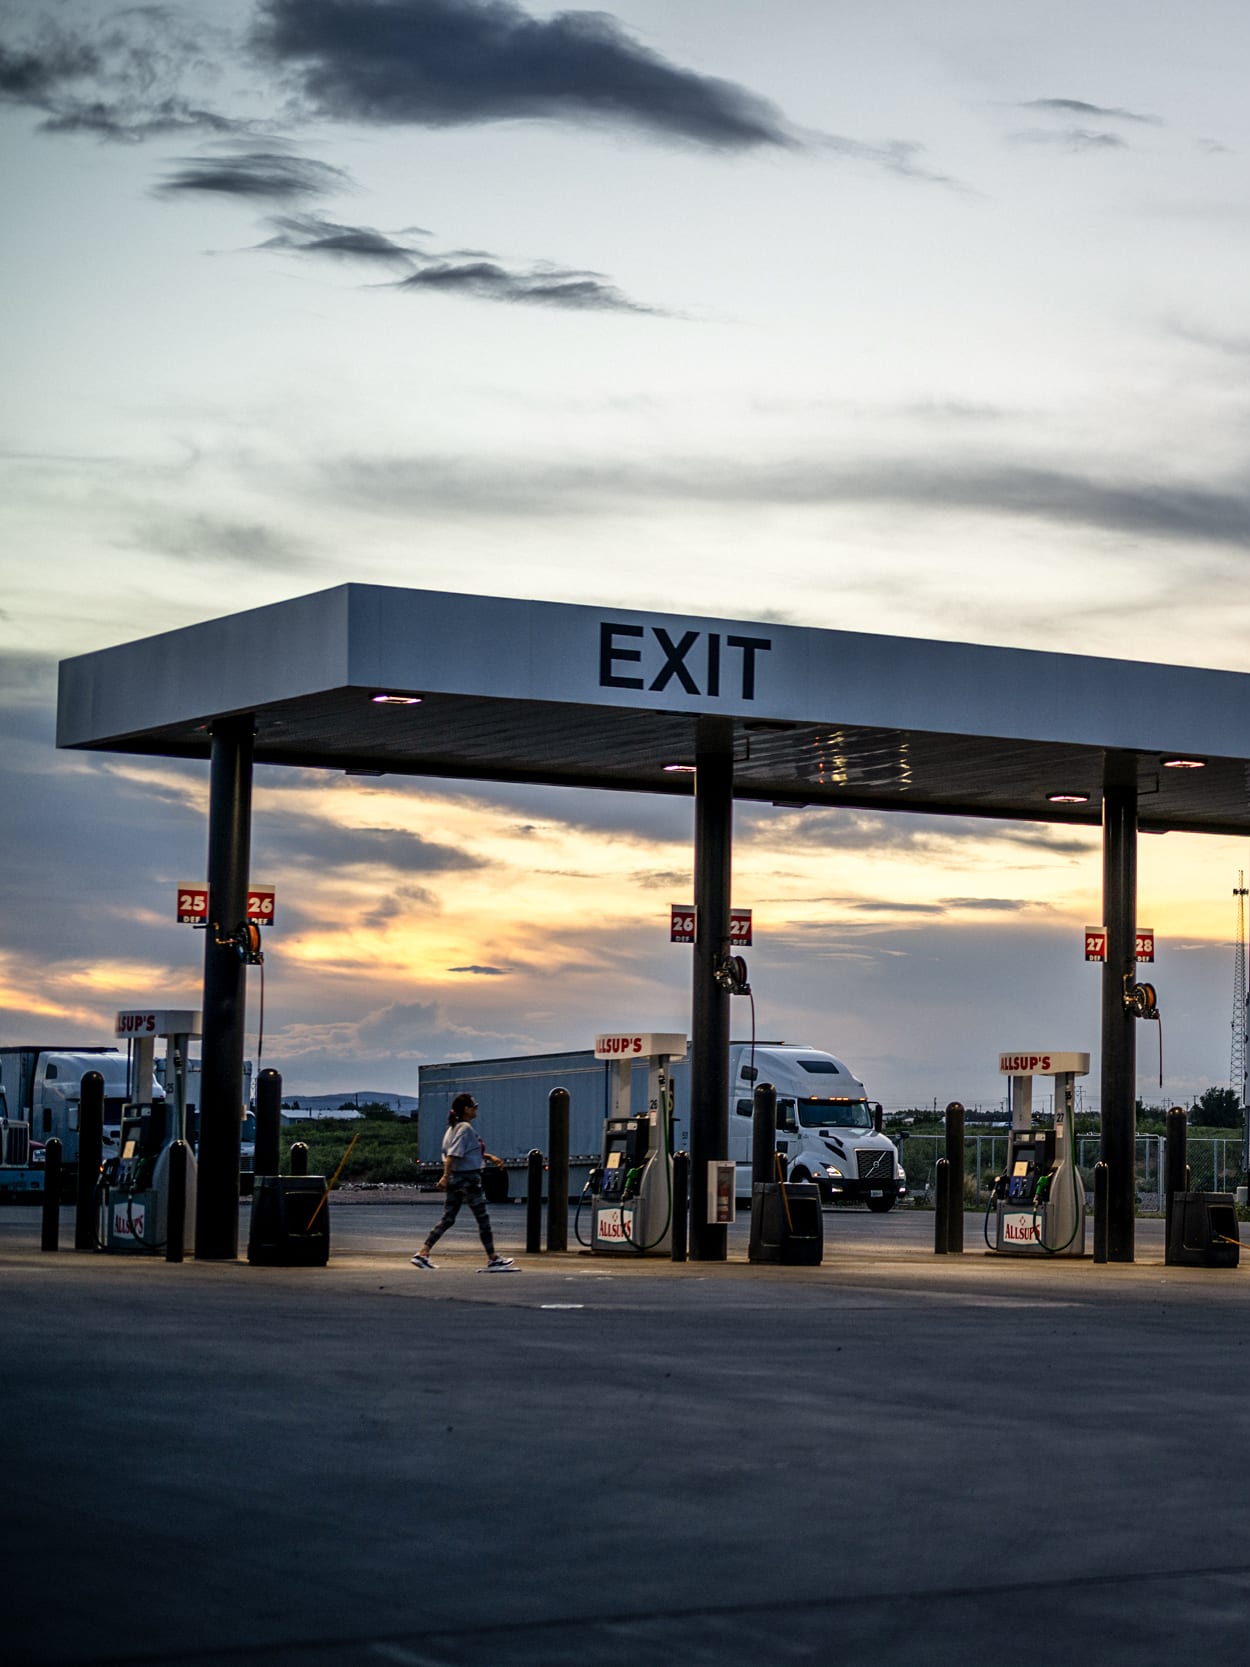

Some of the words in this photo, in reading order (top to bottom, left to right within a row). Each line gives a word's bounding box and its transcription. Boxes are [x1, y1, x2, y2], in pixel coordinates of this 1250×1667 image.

[600, 622, 771, 700] EXIT
[180, 895, 205, 911] 25
[248, 897, 272, 913] 26
[251, 917, 268, 925] DEF
[672, 917, 693, 932] 26
[730, 921, 750, 935] 27
[1087, 938, 1104, 951] 27
[1136, 939, 1152, 952] 28
[1001, 1056, 1050, 1070] ALLSUP'S
[1057, 1113, 1064, 1122] 27
[1005, 1223, 1041, 1240] ALLSUPS
